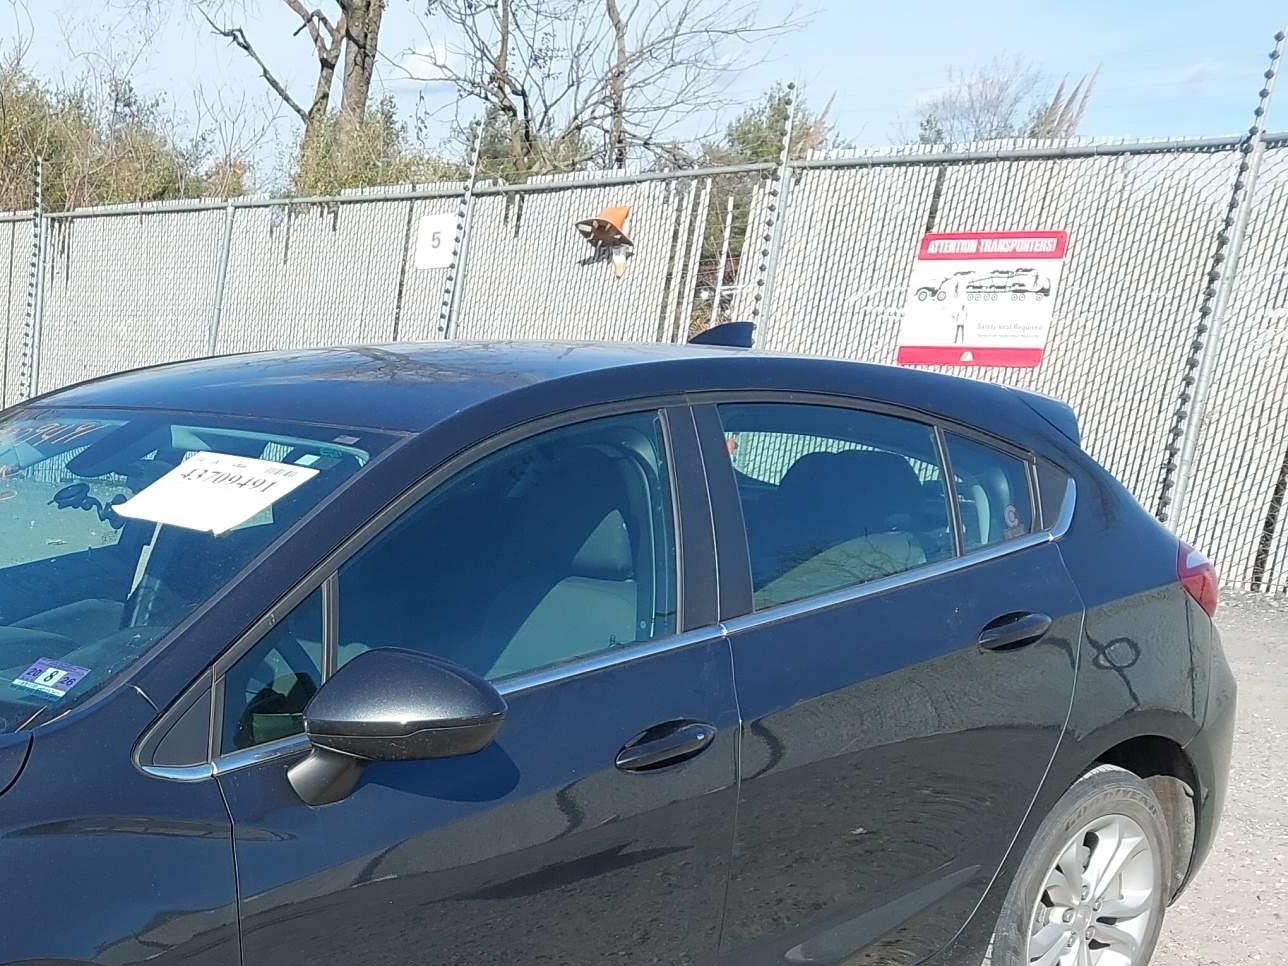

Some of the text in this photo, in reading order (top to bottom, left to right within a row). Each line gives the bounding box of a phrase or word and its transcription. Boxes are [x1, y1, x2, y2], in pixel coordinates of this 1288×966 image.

[432, 231, 441, 249] 5
[927, 237, 1058, 254] ATTENTION TRANSPORTERS!
[180, 467, 278, 493] 43709491
[43, 670, 60, 683] 8
